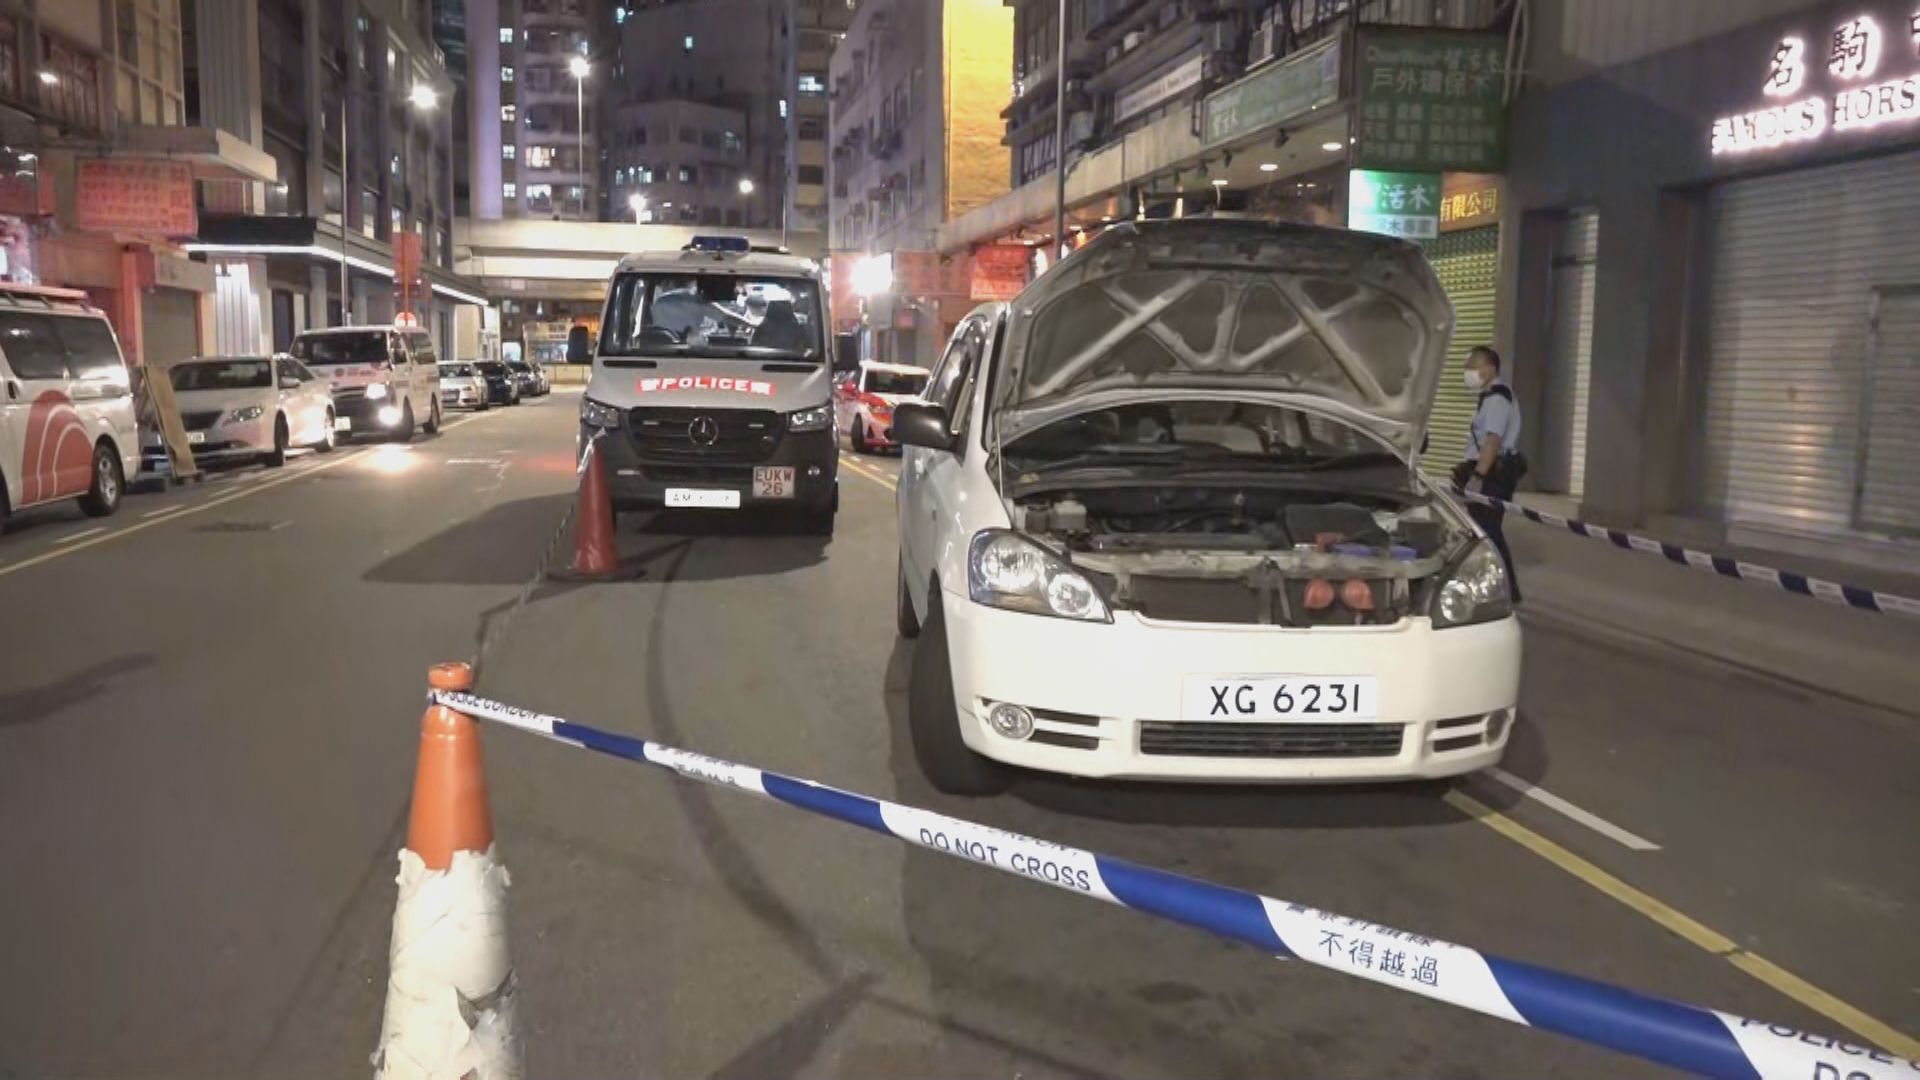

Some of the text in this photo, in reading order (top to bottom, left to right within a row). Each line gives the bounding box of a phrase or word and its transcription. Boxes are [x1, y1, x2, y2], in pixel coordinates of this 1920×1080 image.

[1763, 13, 1920, 88] 名駒
[1367, 183, 1431, 211] 活木
[1440, 187, 1497, 222] 有限公司
[661, 376, 749, 392] POLICE
[755, 467, 793, 482] EUKW
[762, 482, 783, 496] 26
[1210, 684, 1359, 715] XG 6231
[920, 827, 950, 851] DO
[956, 838, 998, 865] NOT
[1011, 853, 1091, 892] CROSS
[1319, 929, 1439, 987] 不得越過
